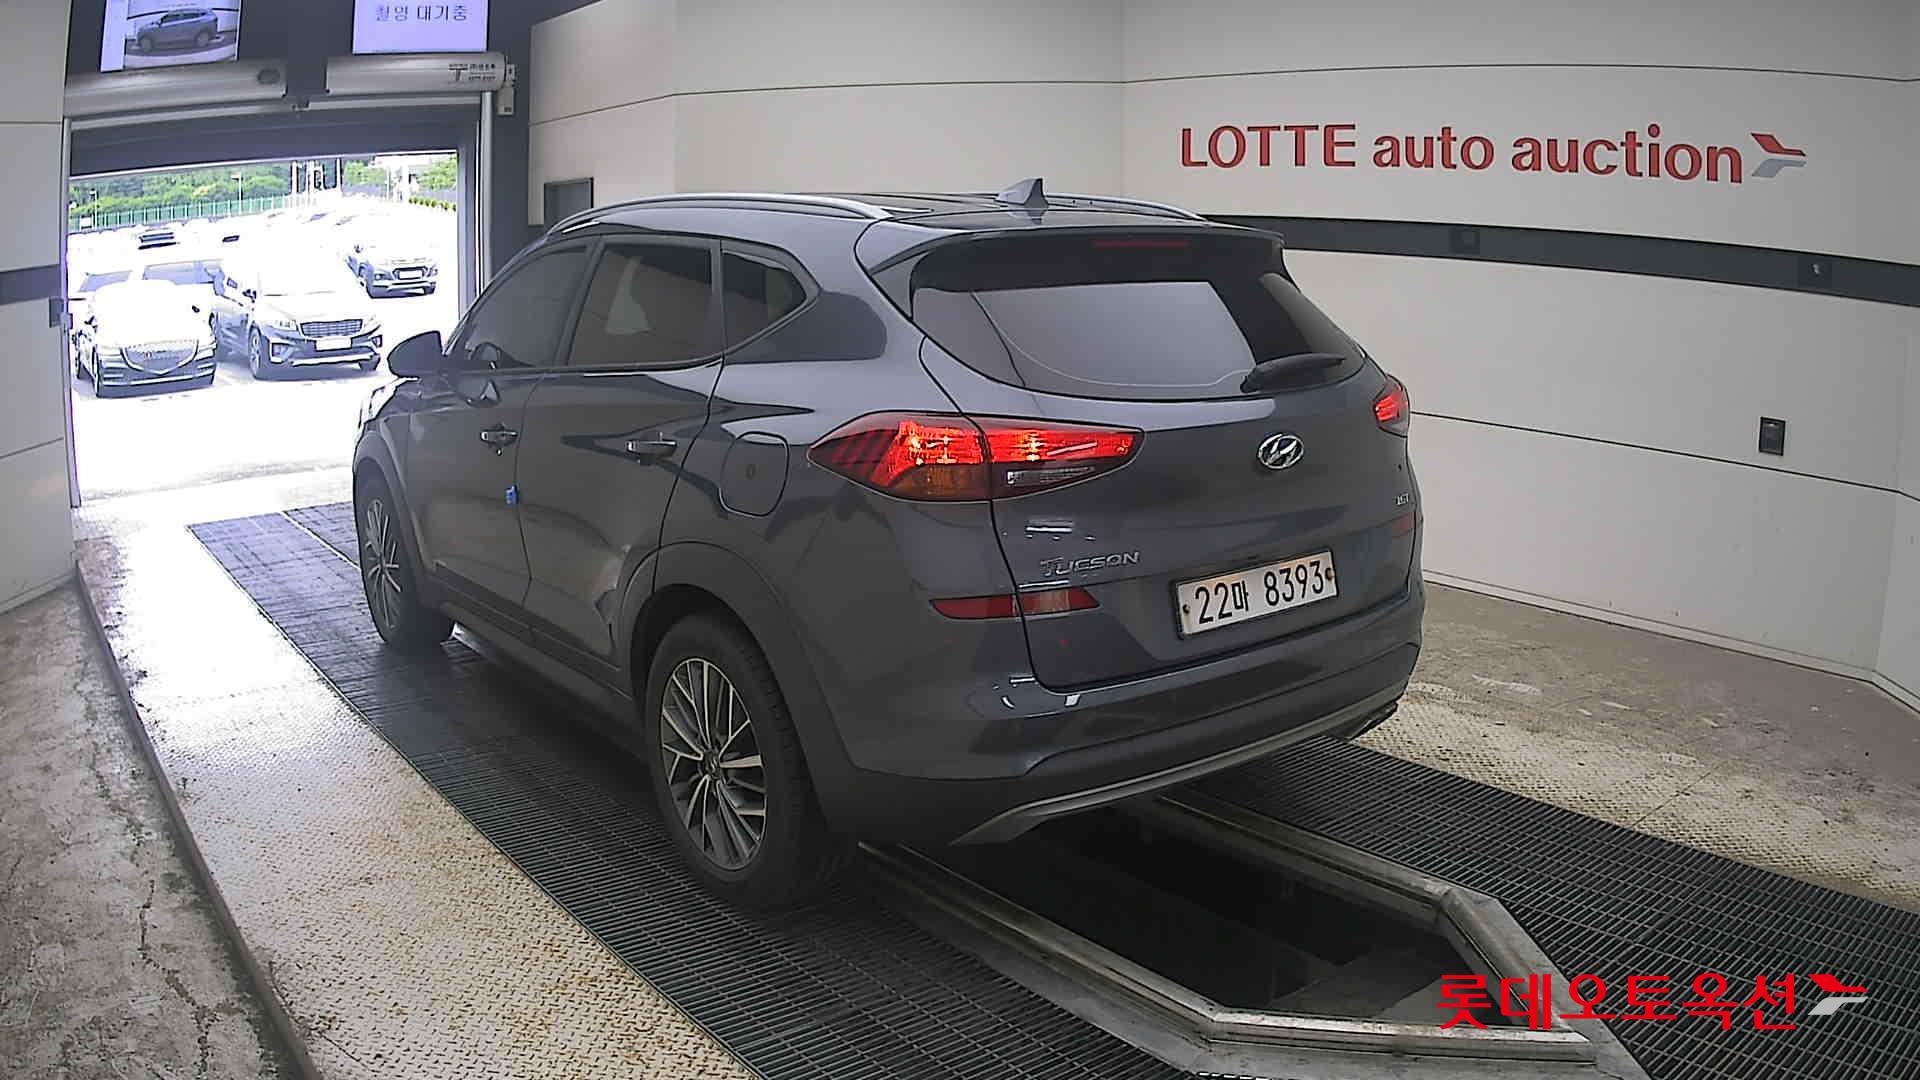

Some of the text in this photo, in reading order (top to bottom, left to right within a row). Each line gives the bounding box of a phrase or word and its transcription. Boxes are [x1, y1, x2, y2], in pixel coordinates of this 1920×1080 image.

[416, 5, 467, 23] 대기중
[1181, 123, 1743, 184] LOTTE auto auction
[1040, 550, 1140, 577] TUCSON
[1194, 560, 1324, 625] 22마 8393
